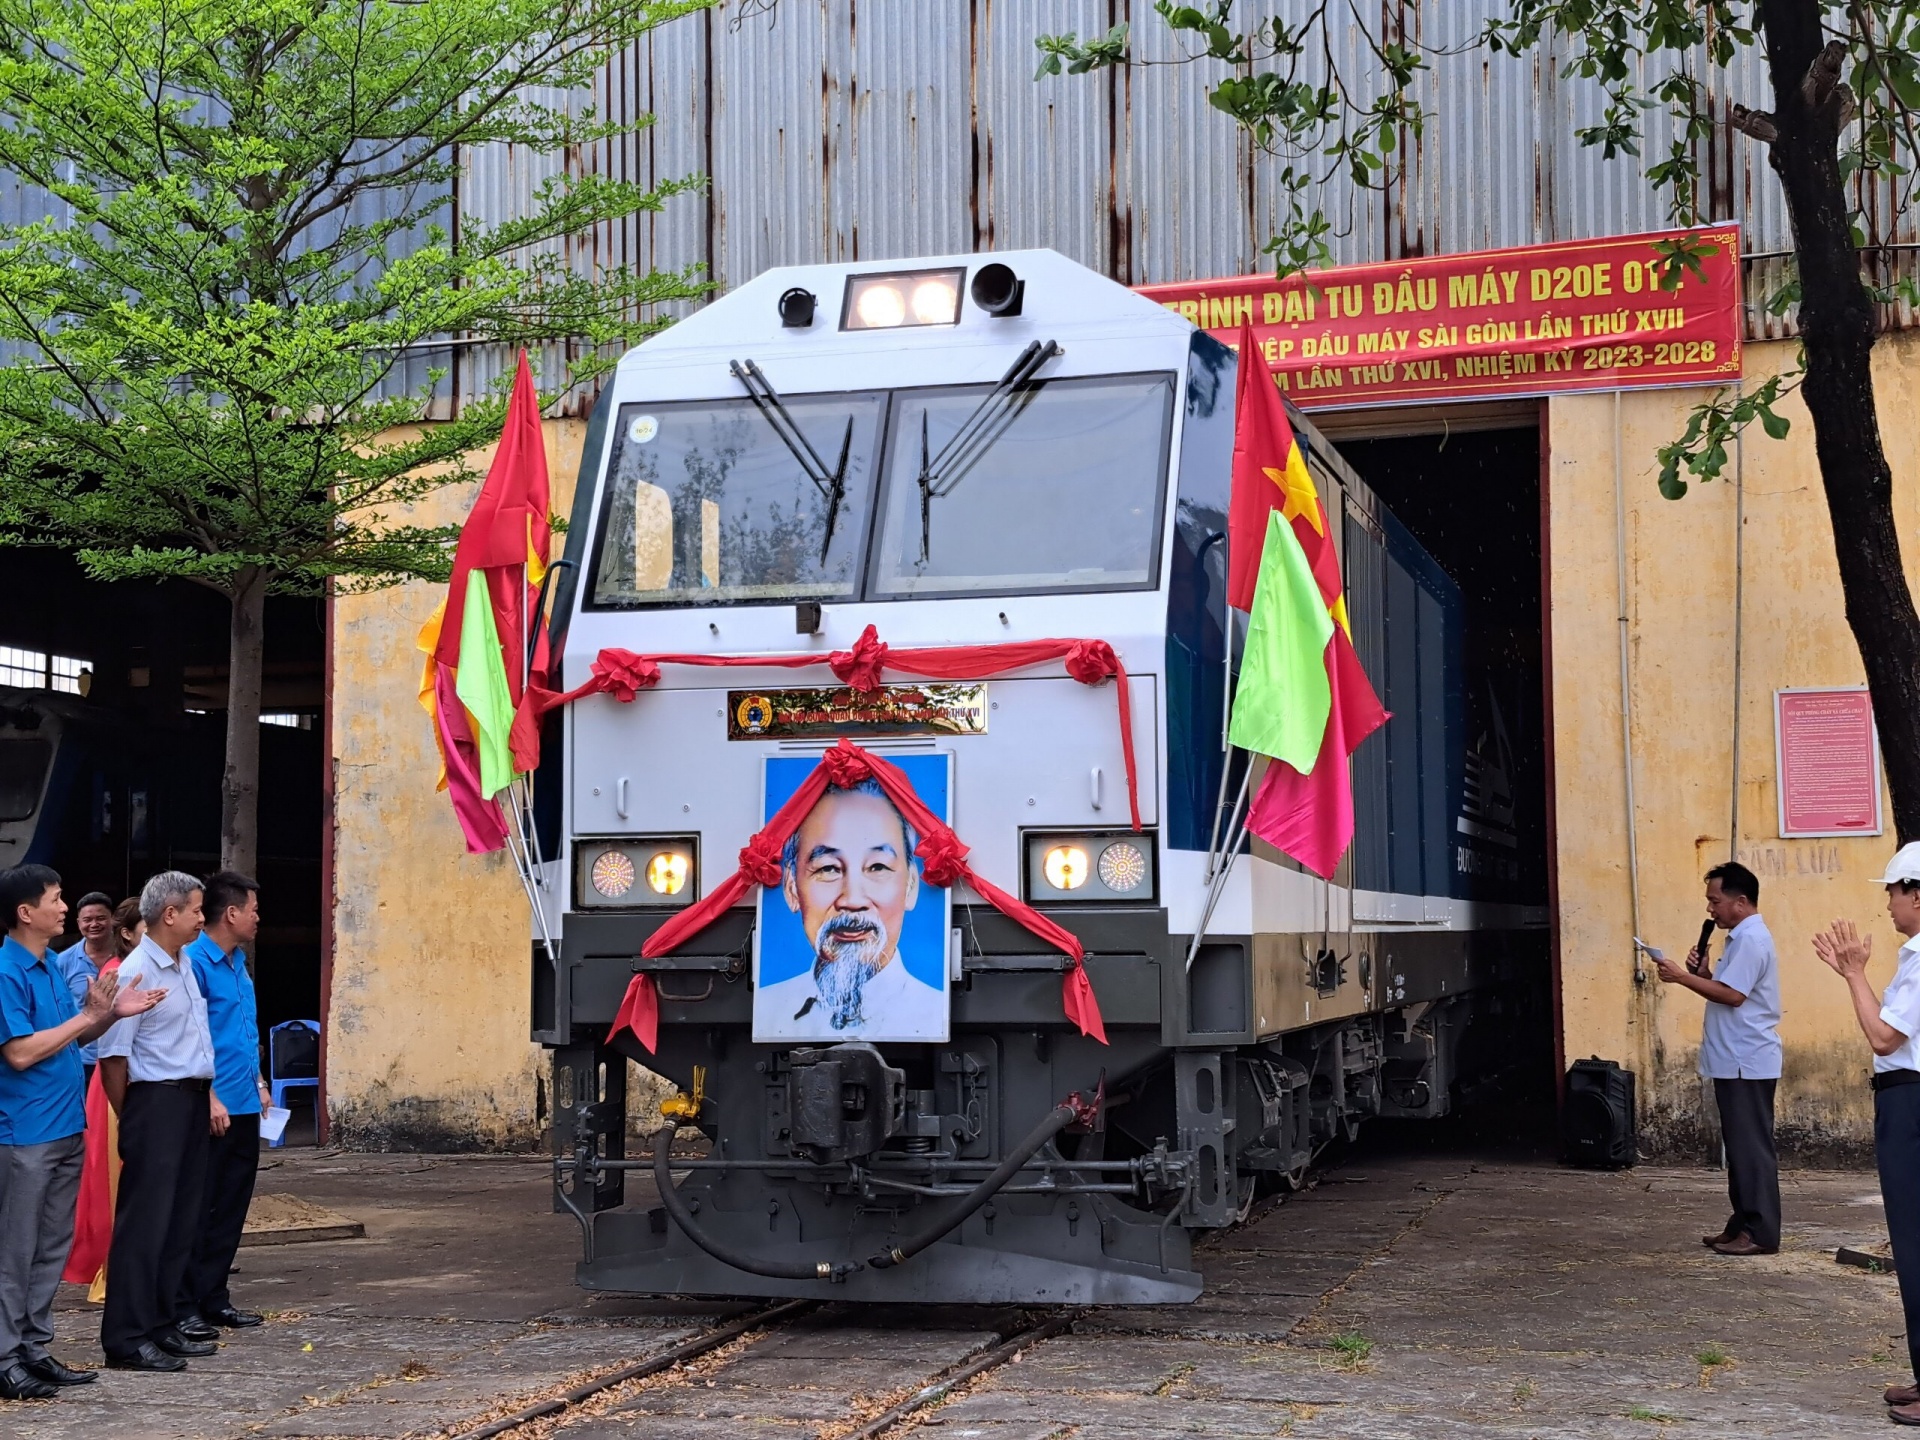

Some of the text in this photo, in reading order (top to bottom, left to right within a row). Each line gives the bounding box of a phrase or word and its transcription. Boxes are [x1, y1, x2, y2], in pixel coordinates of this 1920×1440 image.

[1262, 290, 1315, 329] ĐẠI
[1324, 285, 1363, 319] TU
[1373, 269, 1437, 315] ĐẦU
[1448, 265, 1520, 309] MÁY
[1530, 263, 1612, 301] D20E
[1302, 330, 1349, 358] ĐẦU
[1357, 327, 1410, 353] MÁY
[1418, 319, 1457, 348] SÀI
[1466, 318, 1516, 345] GÒN
[1525, 310, 1572, 341] LẦN
[1580, 307, 1630, 336] THỨ
[1635, 307, 1685, 332] XVII
[1296, 362, 1343, 390] LẦN
[1349, 359, 1396, 386] THỨ
[1401, 358, 1449, 382] XVI,
[1455, 350, 1537, 380] NHIỆM
[1544, 346, 1576, 373] KỲ
[1583, 341, 1716, 371] 2023-2028
